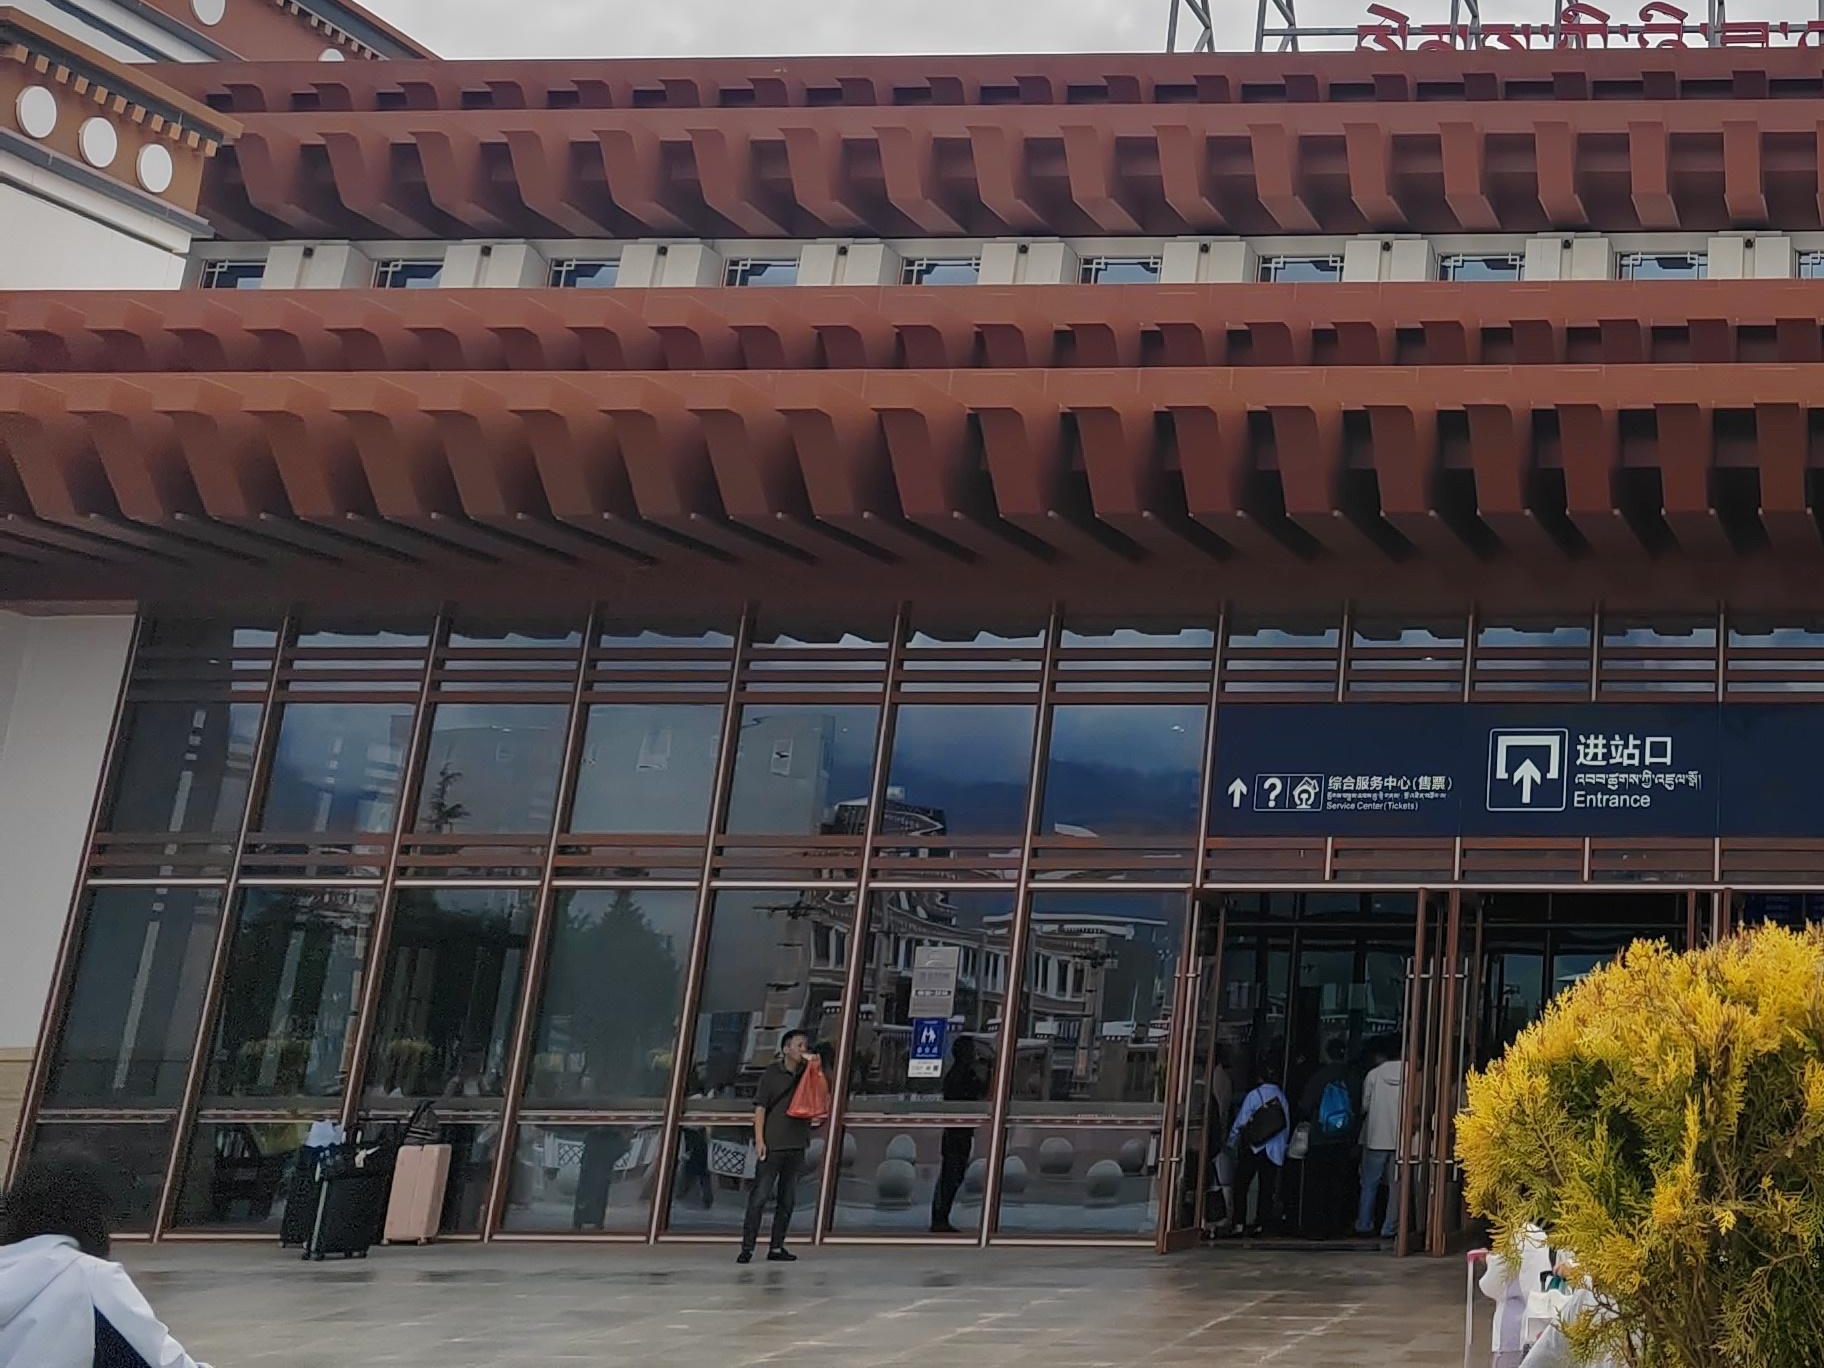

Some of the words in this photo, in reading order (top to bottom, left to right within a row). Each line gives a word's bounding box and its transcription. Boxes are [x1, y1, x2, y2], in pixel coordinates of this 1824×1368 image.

[1575, 734, 1672, 766] 进站口
[1326, 801, 1355, 810] Service
[1573, 790, 1651, 807] Entrance
